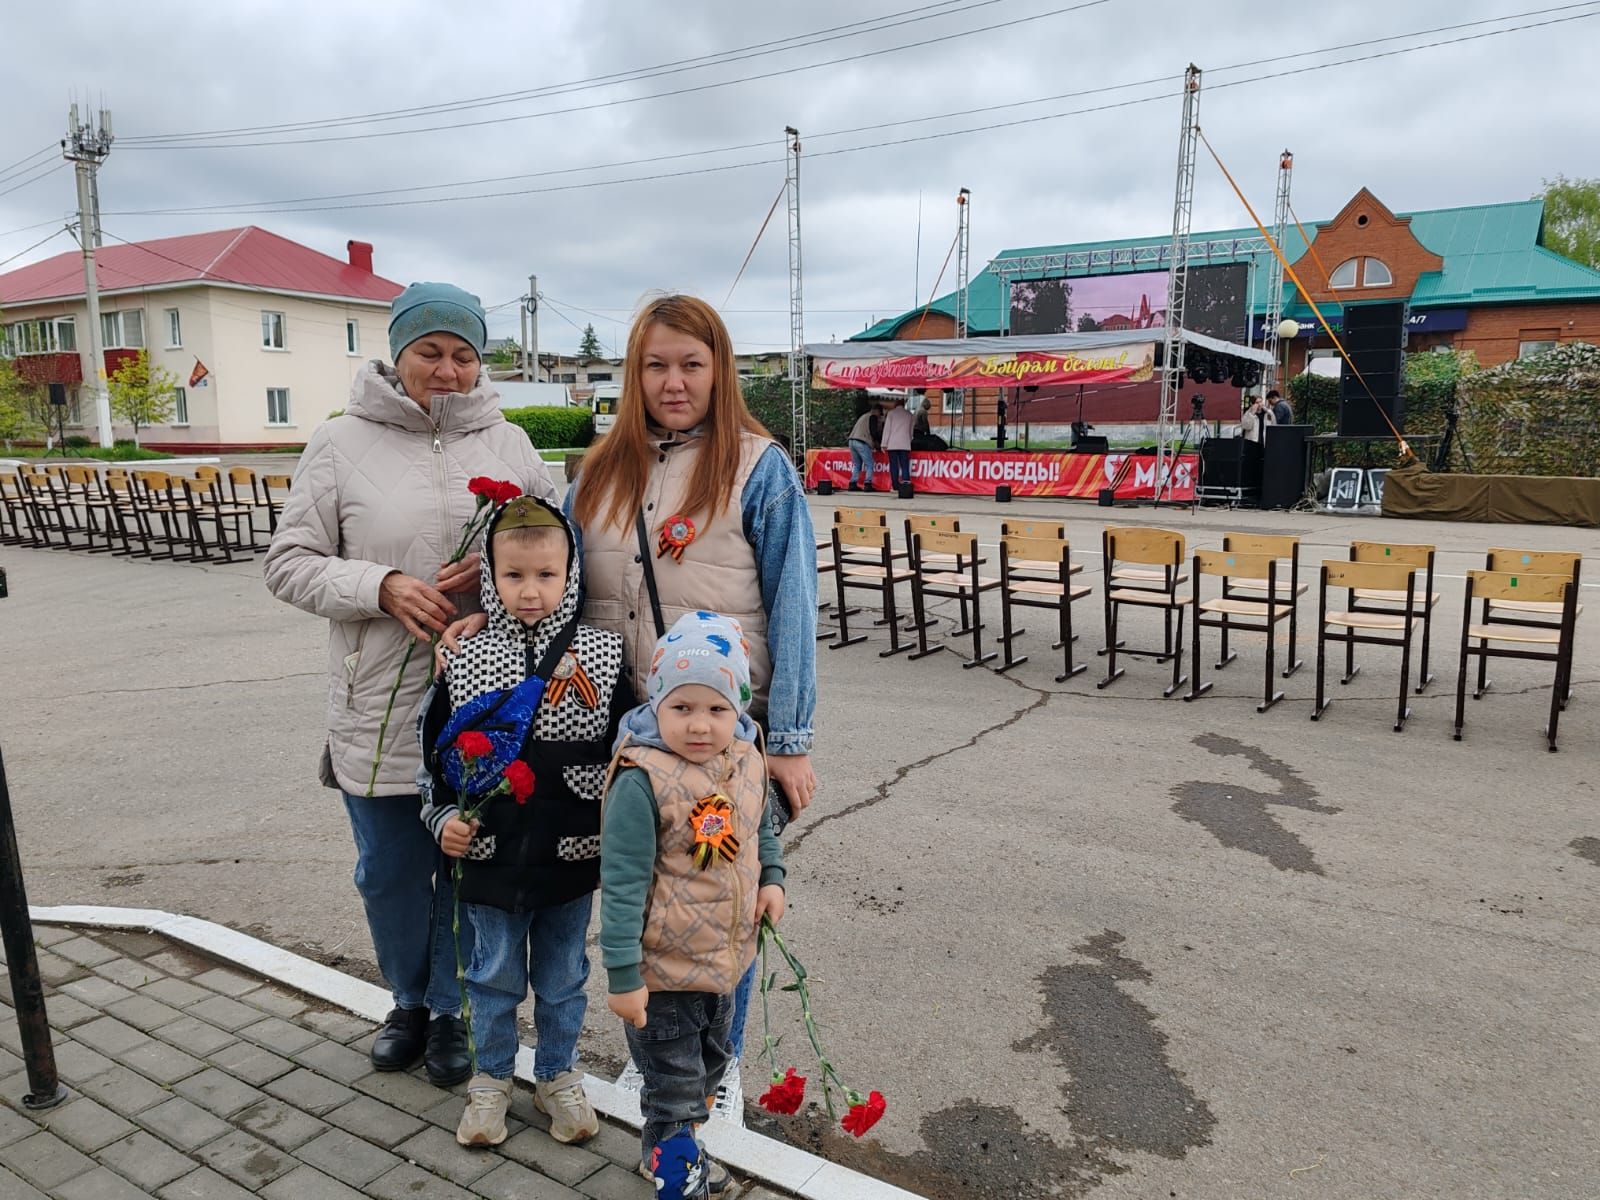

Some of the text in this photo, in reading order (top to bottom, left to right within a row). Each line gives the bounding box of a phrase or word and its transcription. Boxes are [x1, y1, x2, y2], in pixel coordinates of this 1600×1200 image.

[1297, 321, 1315, 330] анк
[1409, 315, 1427, 324] 4/7
[824, 360, 837, 377] С
[980, 354, 1057, 380] Бәйрәм
[824, 460, 832, 471] С
[908, 453, 974, 479] ЕЛИКОЙ
[979, 459, 1060, 485] ПОБЕДЫ!
